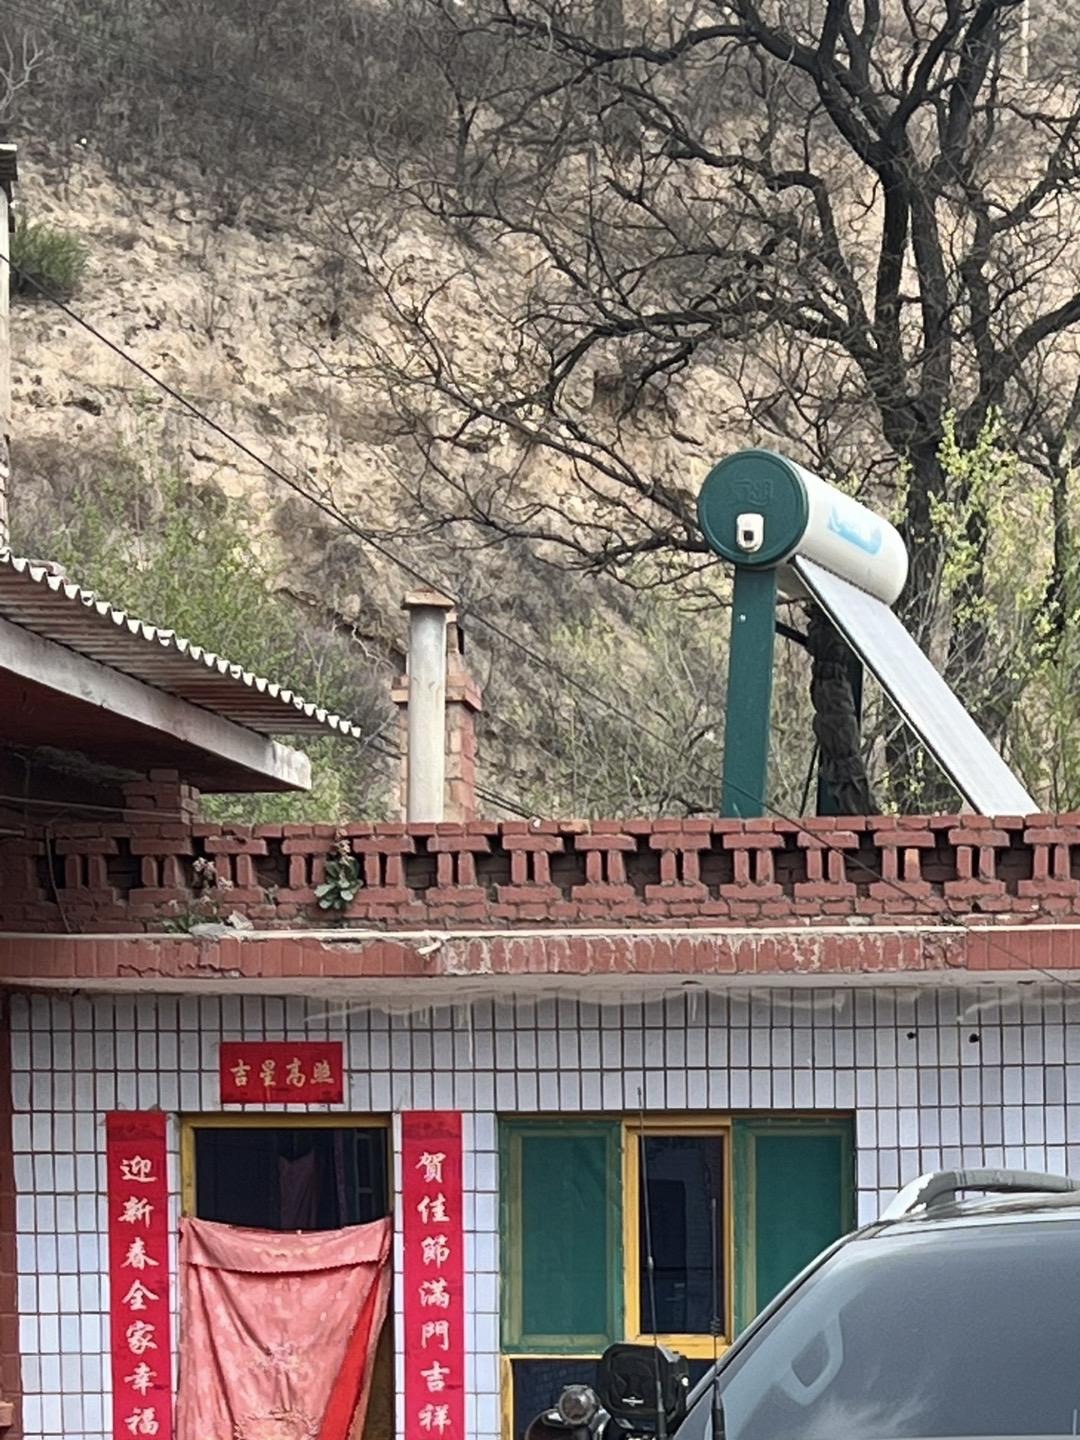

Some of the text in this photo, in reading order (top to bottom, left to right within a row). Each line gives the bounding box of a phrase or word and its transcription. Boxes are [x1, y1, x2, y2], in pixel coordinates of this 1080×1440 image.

[230, 1057, 335, 1088] 吉星高照
[117, 1154, 160, 1436] 迎新春全家幸福
